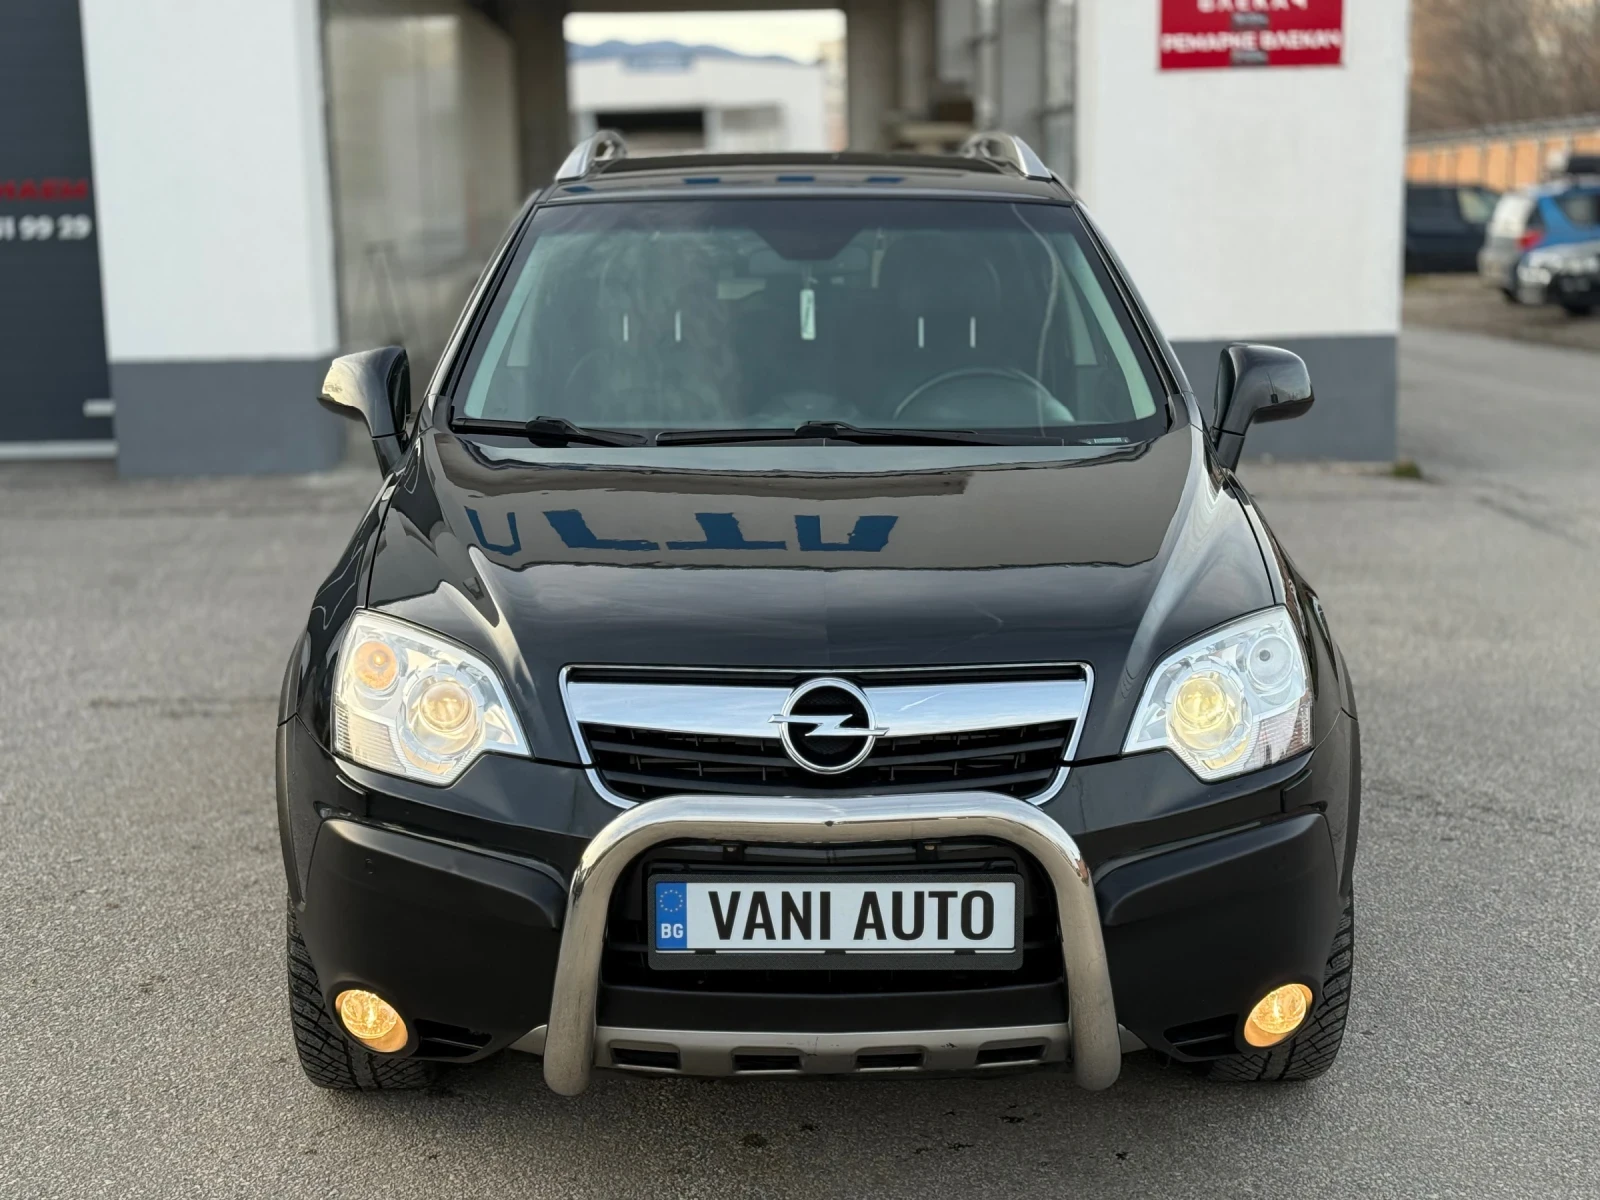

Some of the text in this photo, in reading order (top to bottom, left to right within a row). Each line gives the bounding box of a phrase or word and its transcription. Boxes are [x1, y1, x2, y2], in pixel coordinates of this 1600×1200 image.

[18, 214, 55, 241] 99
[57, 213, 92, 240] 29
[708, 890, 995, 941] VANI AUTO
[660, 923, 684, 939] BG
